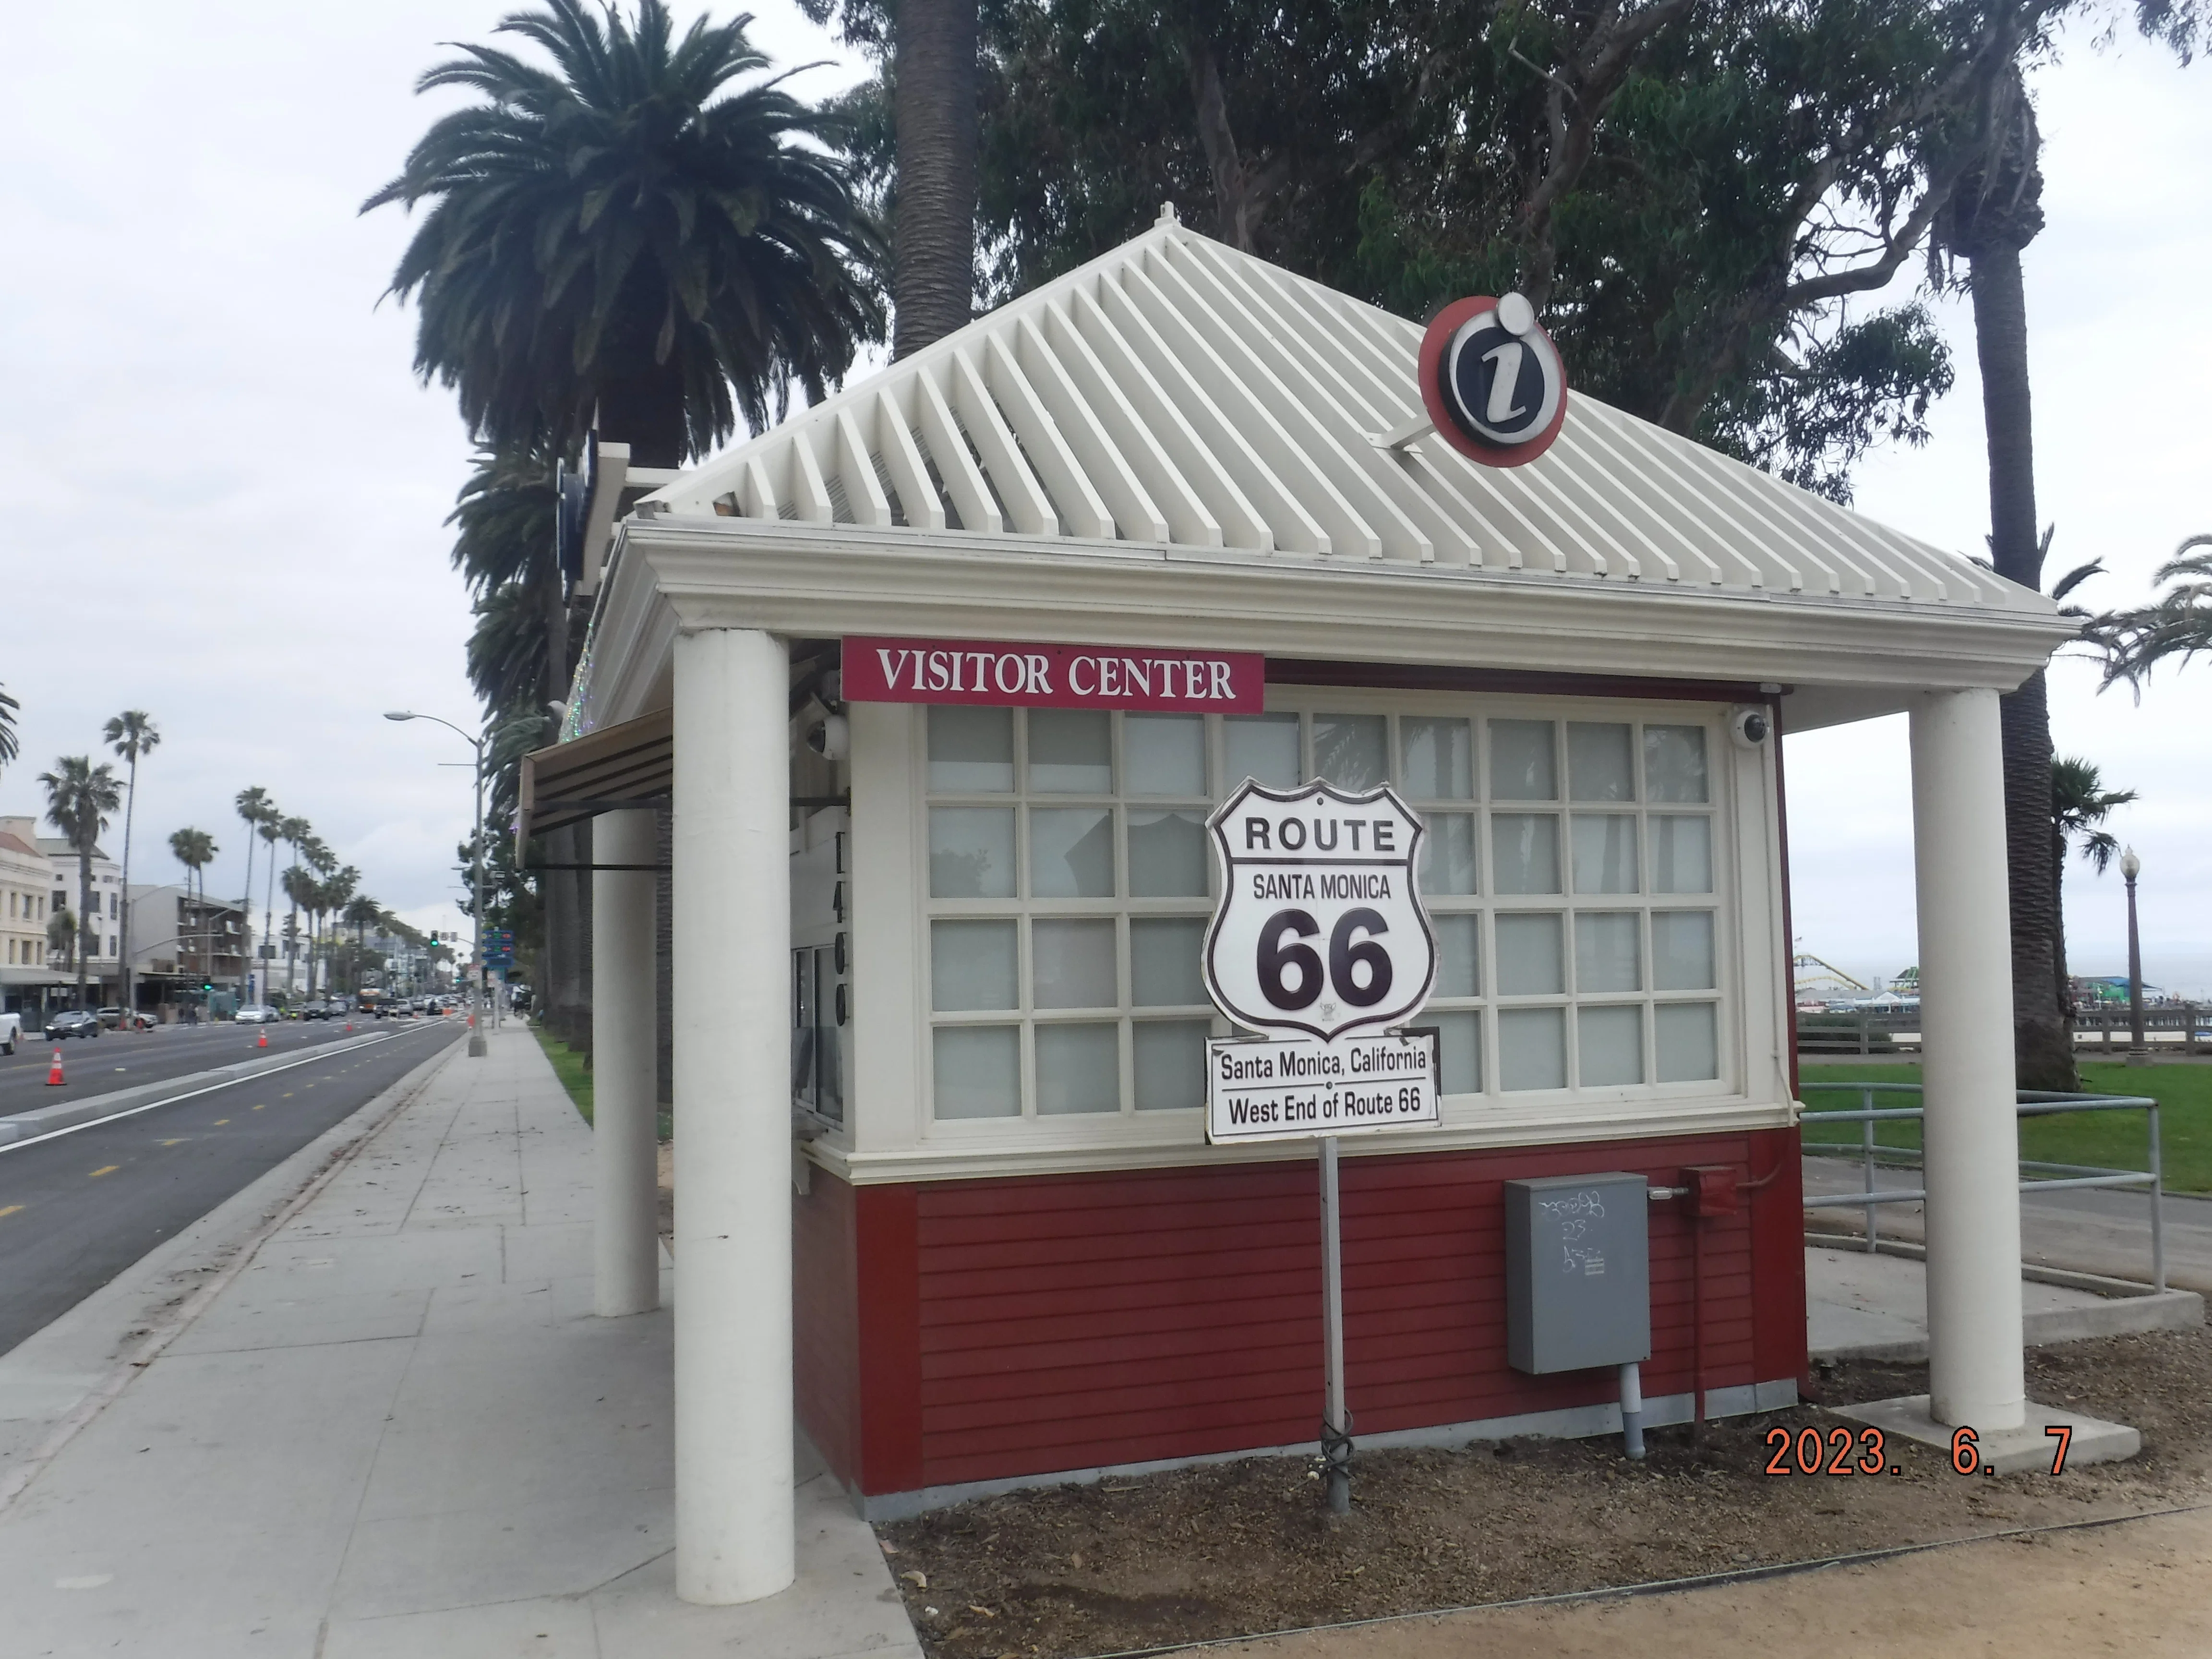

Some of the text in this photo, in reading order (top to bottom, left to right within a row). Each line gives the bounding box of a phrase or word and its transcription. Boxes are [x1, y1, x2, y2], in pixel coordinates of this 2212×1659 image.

[876, 649, 1237, 700] VISITOR CENTER
[1245, 817, 1395, 852] ROUTE
[1253, 874, 1391, 899] SANTA MONICA
[1257, 907, 1393, 1010] 66
[1221, 1046, 1426, 1080] Santa Monica, California
[1228, 1087, 1421, 1125] West End of Route 66
